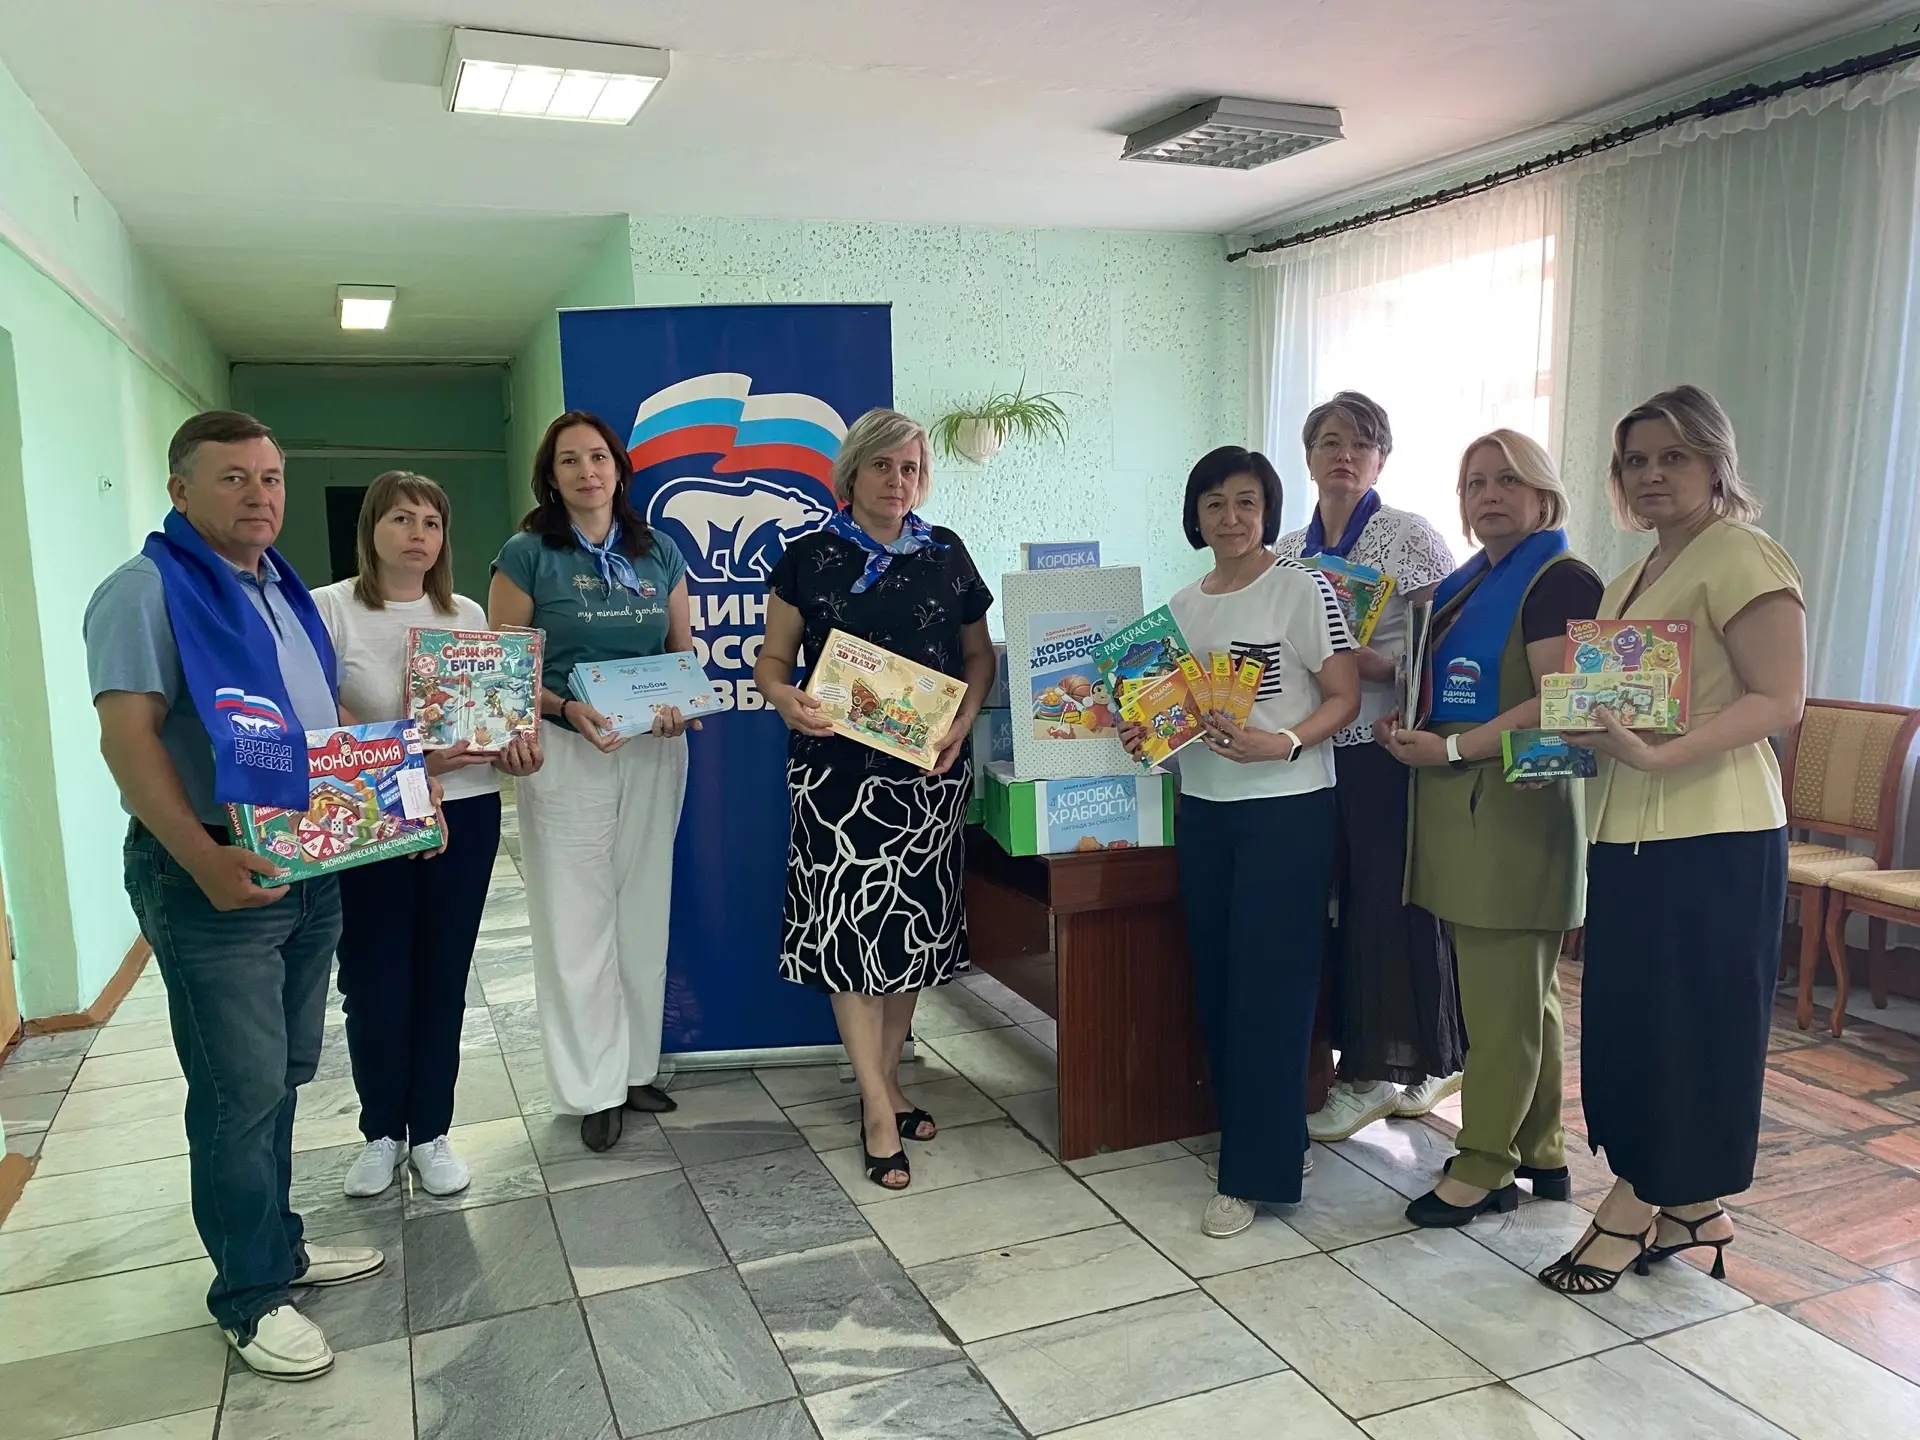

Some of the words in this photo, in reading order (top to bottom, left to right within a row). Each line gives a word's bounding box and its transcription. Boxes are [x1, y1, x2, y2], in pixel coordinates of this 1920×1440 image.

[1037, 551, 1095, 569] КОРОБКА
[578, 611, 593, 622] my
[596, 606, 632, 618] minimal
[636, 603, 665, 623] garden
[688, 594, 770, 631] ДИН
[1104, 612, 1168, 655] РАСКРАСКА
[1574, 623, 1593, 632] 1600
[1036, 632, 1104, 656] КОРОБКА
[450, 659, 495, 672] БИТВА
[836, 650, 848, 660] 3D
[850, 656, 876, 672] ПАЗЛ
[1030, 644, 1100, 669] ХРАБРОС
[632, 682, 668, 691] Альбом
[1149, 682, 1172, 700] АЛЬБОМ
[1443, 690, 1476, 698] ЕДИНАЯ
[235, 738, 291, 757] ЕДИНАЯ
[236, 751, 292, 772] РОССИЯ
[308, 746, 401, 773] МОНОПОЛИЯ
[1056, 784, 1125, 809] КОРОБКА
[1048, 798, 1136, 826] ХРАБРОСТИ
[309, 842, 318, 851] 70
[320, 846, 379, 870] ЭКОНОМИЧЕСКАЯ
[380, 834, 418, 853] НАСТОЛЬНАЯ
[336, 844, 345, 852] 50
